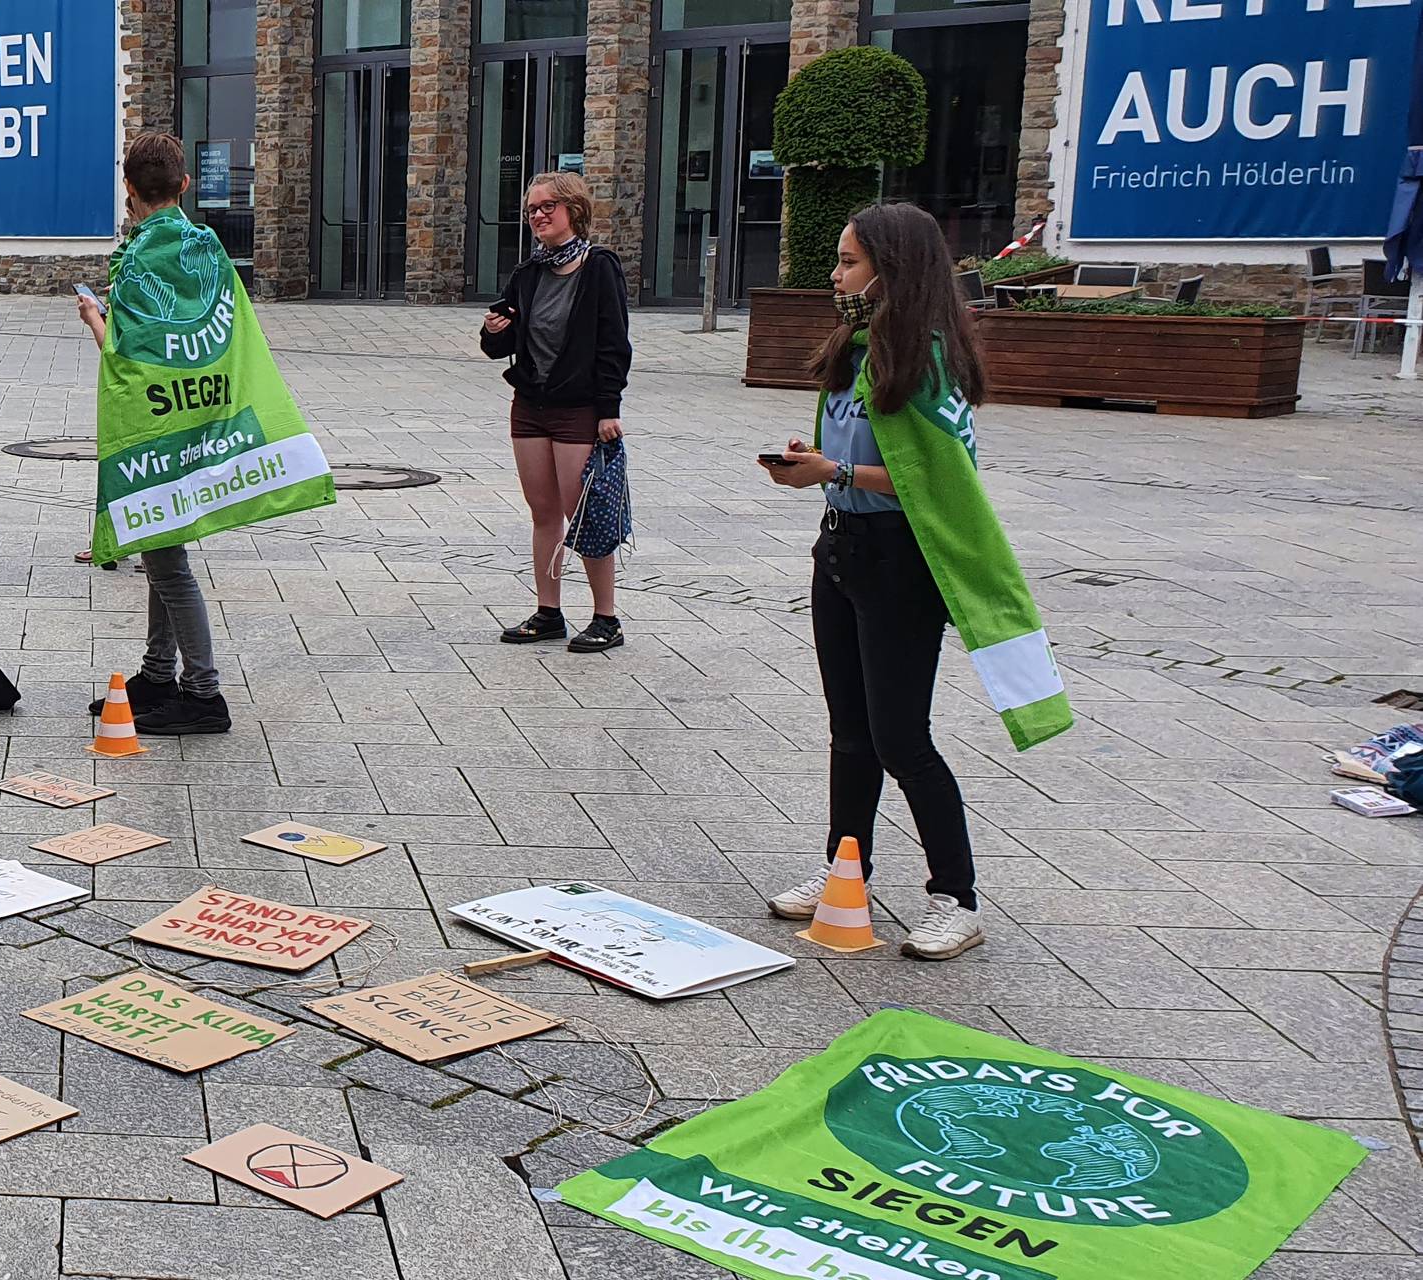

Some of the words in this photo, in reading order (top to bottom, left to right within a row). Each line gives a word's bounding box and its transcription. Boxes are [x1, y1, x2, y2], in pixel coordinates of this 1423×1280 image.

[1096, 58, 1369, 146] AUCH
[1091, 164, 1212, 190] Friedrich
[1221, 159, 1356, 186] Hölderlin
[165, 283, 235, 362] FUTURE
[117, 449, 171, 485] Wir
[123, 502, 165, 531] bis
[48, 840, 105, 860] CRISIS
[71, 834, 131, 851] EVERY
[91, 825, 161, 845] FIGHT
[197, 908, 278, 933] WHAT
[273, 926, 331, 946] YOU
[199, 893, 297, 921] STAND
[297, 915, 359, 934] FOR
[523, 926, 558, 942] STAY
[88, 993, 198, 1033] WARTET
[120, 980, 190, 1009] DAS
[192, 1010, 277, 1045] KLIMA
[354, 994, 470, 1043] SCIENCE
[400, 991, 492, 1032] BEHIND
[418, 980, 531, 1025] UNITE
[60, 1003, 169, 1045] NICHT!
[861, 1060, 1079, 1093] FRIDAYS
[1092, 1082, 1202, 1139] FOR
[699, 1175, 786, 1218] Wir
[895, 1160, 1172, 1221] FUTURE
[643, 1199, 713, 1233] bis
[722, 1228, 797, 1262] Ihr
[807, 1168, 1059, 1258] SIEGEN
